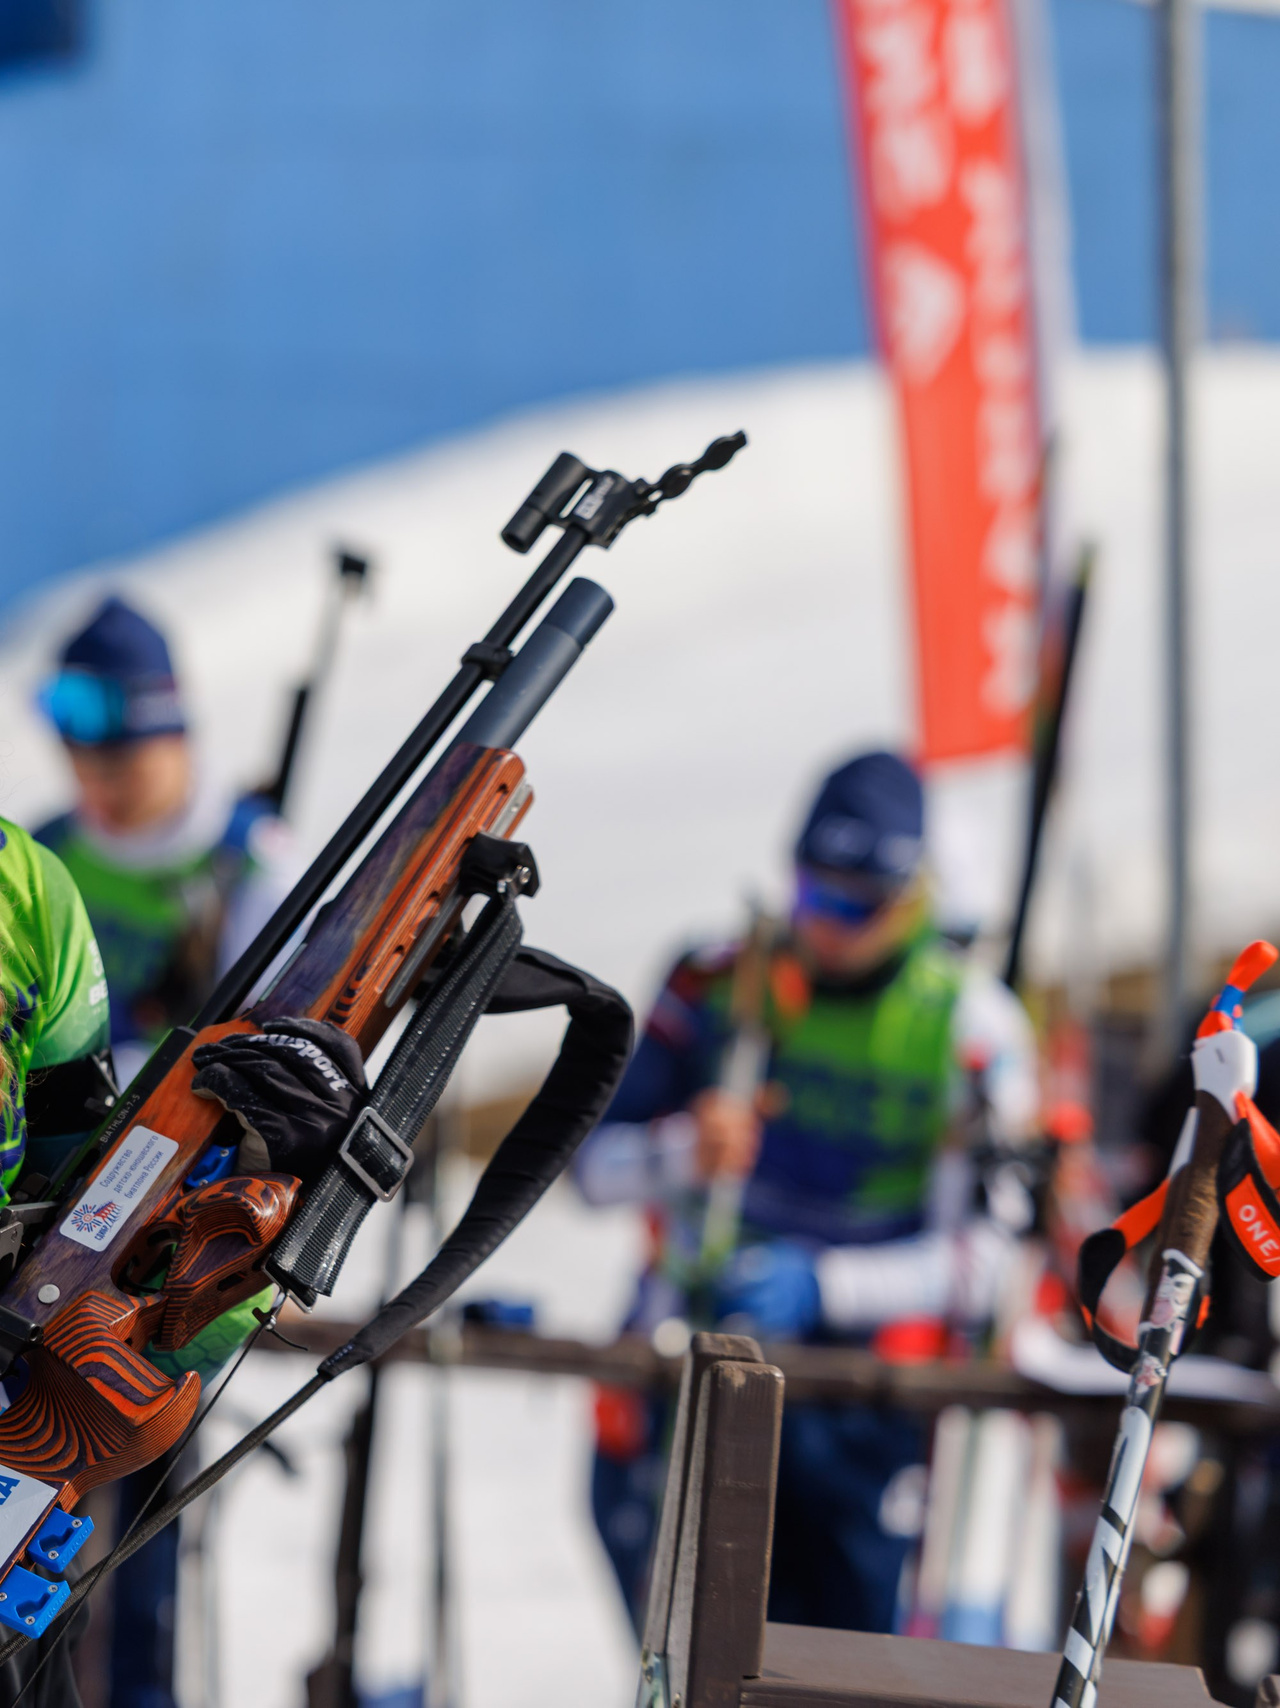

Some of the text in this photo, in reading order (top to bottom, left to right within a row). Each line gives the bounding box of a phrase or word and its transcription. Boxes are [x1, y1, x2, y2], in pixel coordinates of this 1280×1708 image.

[99, 1148, 134, 1188] Содружество
[124, 1150, 164, 1199] биатлона России
